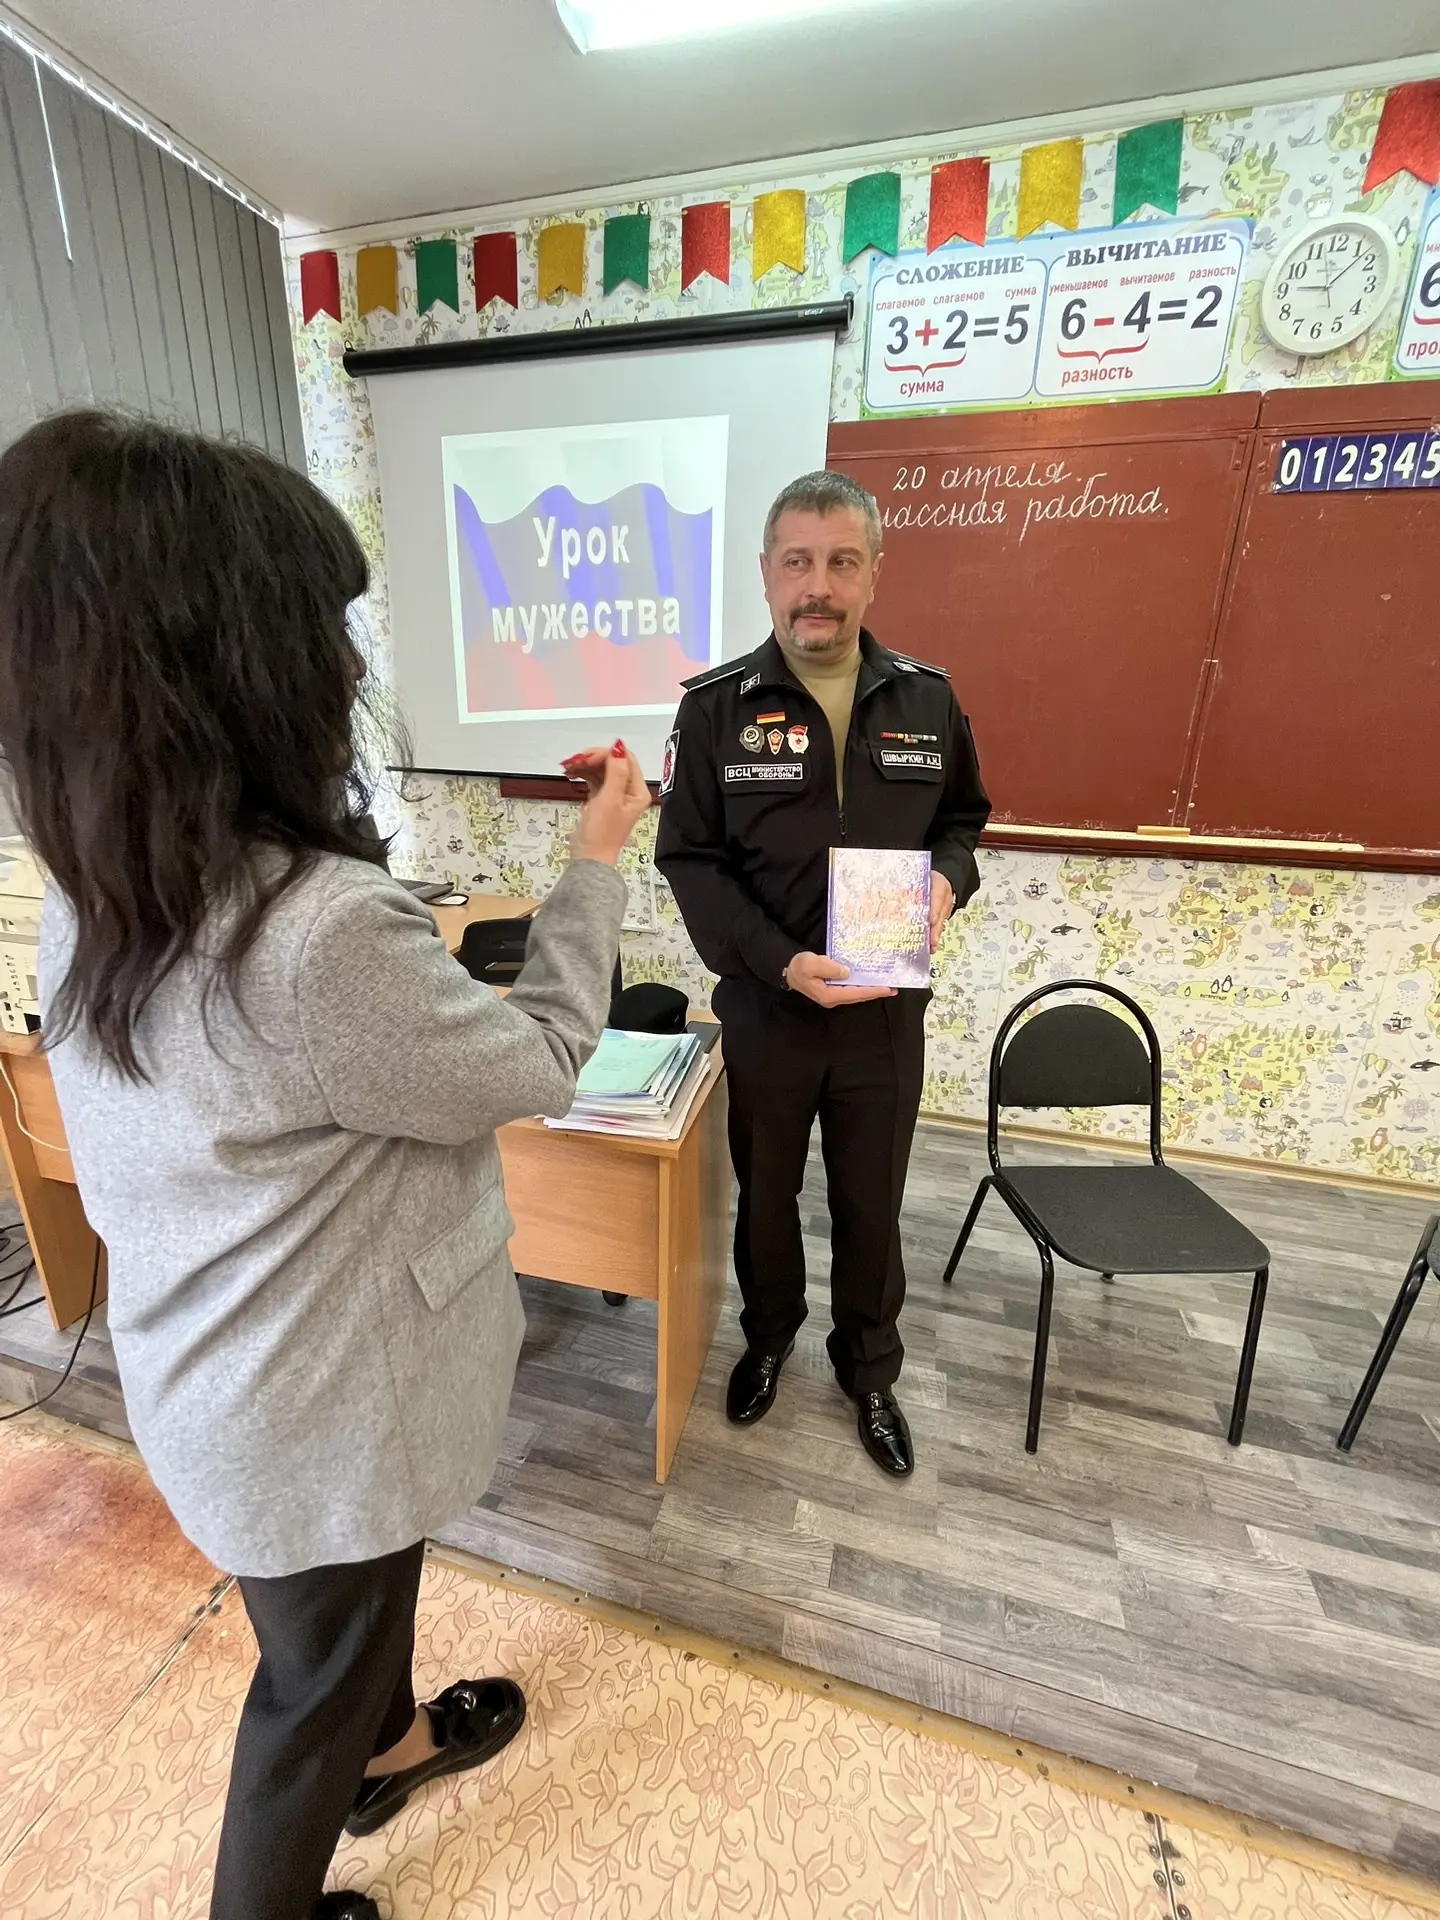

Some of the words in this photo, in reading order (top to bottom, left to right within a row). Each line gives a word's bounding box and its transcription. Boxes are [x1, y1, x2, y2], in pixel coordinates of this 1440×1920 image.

[1066, 232, 1228, 268] ВЫЧИТАНИЕ
[1306, 242, 1324, 261] 11
[1328, 234, 1349, 252] 12
[1352, 239, 1364, 258] 1
[896, 256, 1025, 285] СЛОЖЕНИЕ
[1286, 261, 1307, 280] 10
[1362, 253, 1376, 271] 2
[1049, 279, 1109, 296] уменьшаемое
[1120, 271, 1176, 287] вычитаемое
[1188, 265, 1237, 282] разность
[1364, 275, 1377, 293] 3
[876, 298, 926, 311] слагаемое
[933, 291, 985, 305] слагаемое
[1005, 286, 1037, 300] сумма
[1276, 283, 1289, 300] 9
[1278, 304, 1291, 321] 8
[1349, 298, 1362, 315] 4
[1292, 319, 1305, 335] 7
[1310, 322, 1322, 339] 6
[1331, 316, 1344, 333] 5
[1406, 341, 1440, 360] про
[1061, 366, 1134, 387] разность
[900, 379, 944, 396] сумма
[1280, 447, 1301, 486] 0
[1313, 446, 1328, 484] 1
[1334, 444, 1358, 483] 2
[1363, 443, 1387, 481] 3
[1393, 442, 1417, 480] 4
[1420, 440, 1440, 479] 5
[893, 466, 926, 491] 20
[1018, 472, 1169, 548] работа.
[532, 516, 630, 579] Урок
[491, 597, 681, 654] мужества
[728, 767, 751, 778] ВСЦ
